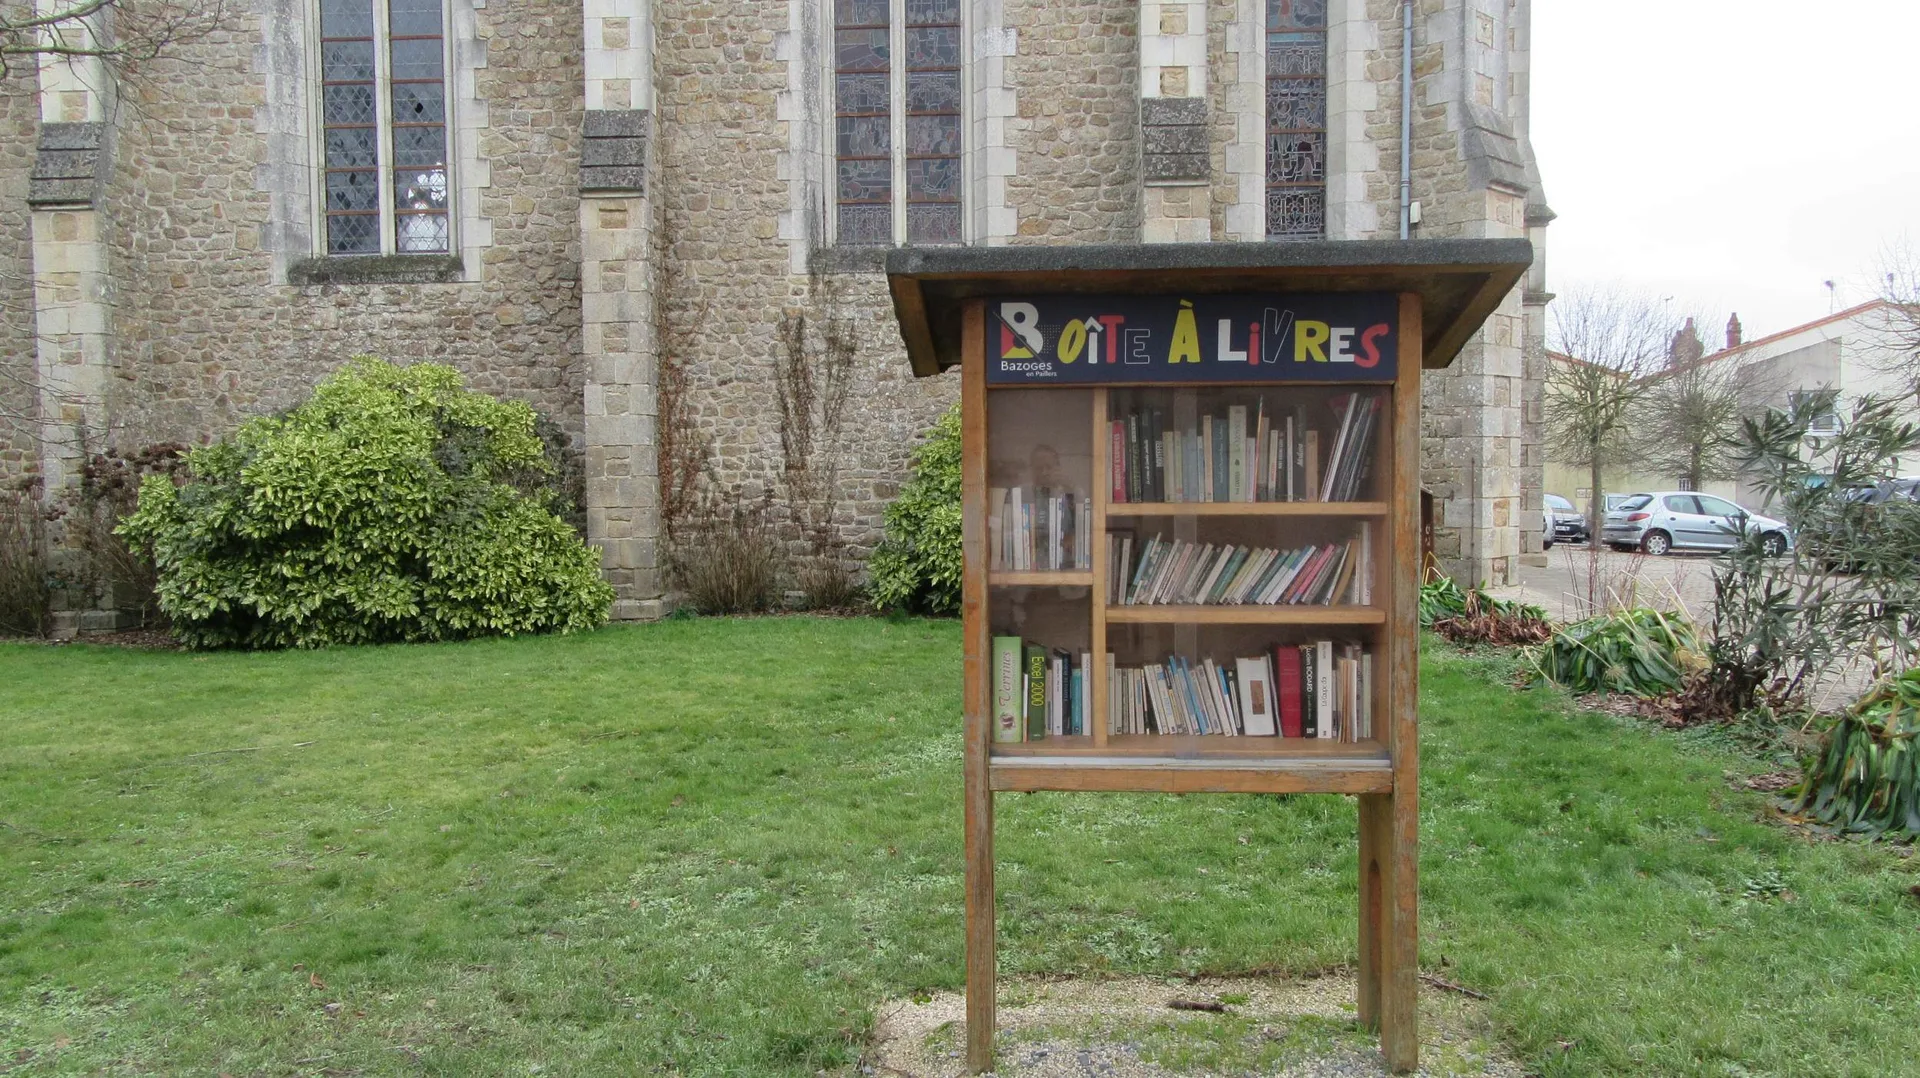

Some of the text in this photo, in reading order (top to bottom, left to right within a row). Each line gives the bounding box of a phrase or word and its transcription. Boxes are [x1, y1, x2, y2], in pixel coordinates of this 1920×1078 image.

[1168, 299, 1200, 364] À
[1031, 656, 1044, 706] Excel 2000
